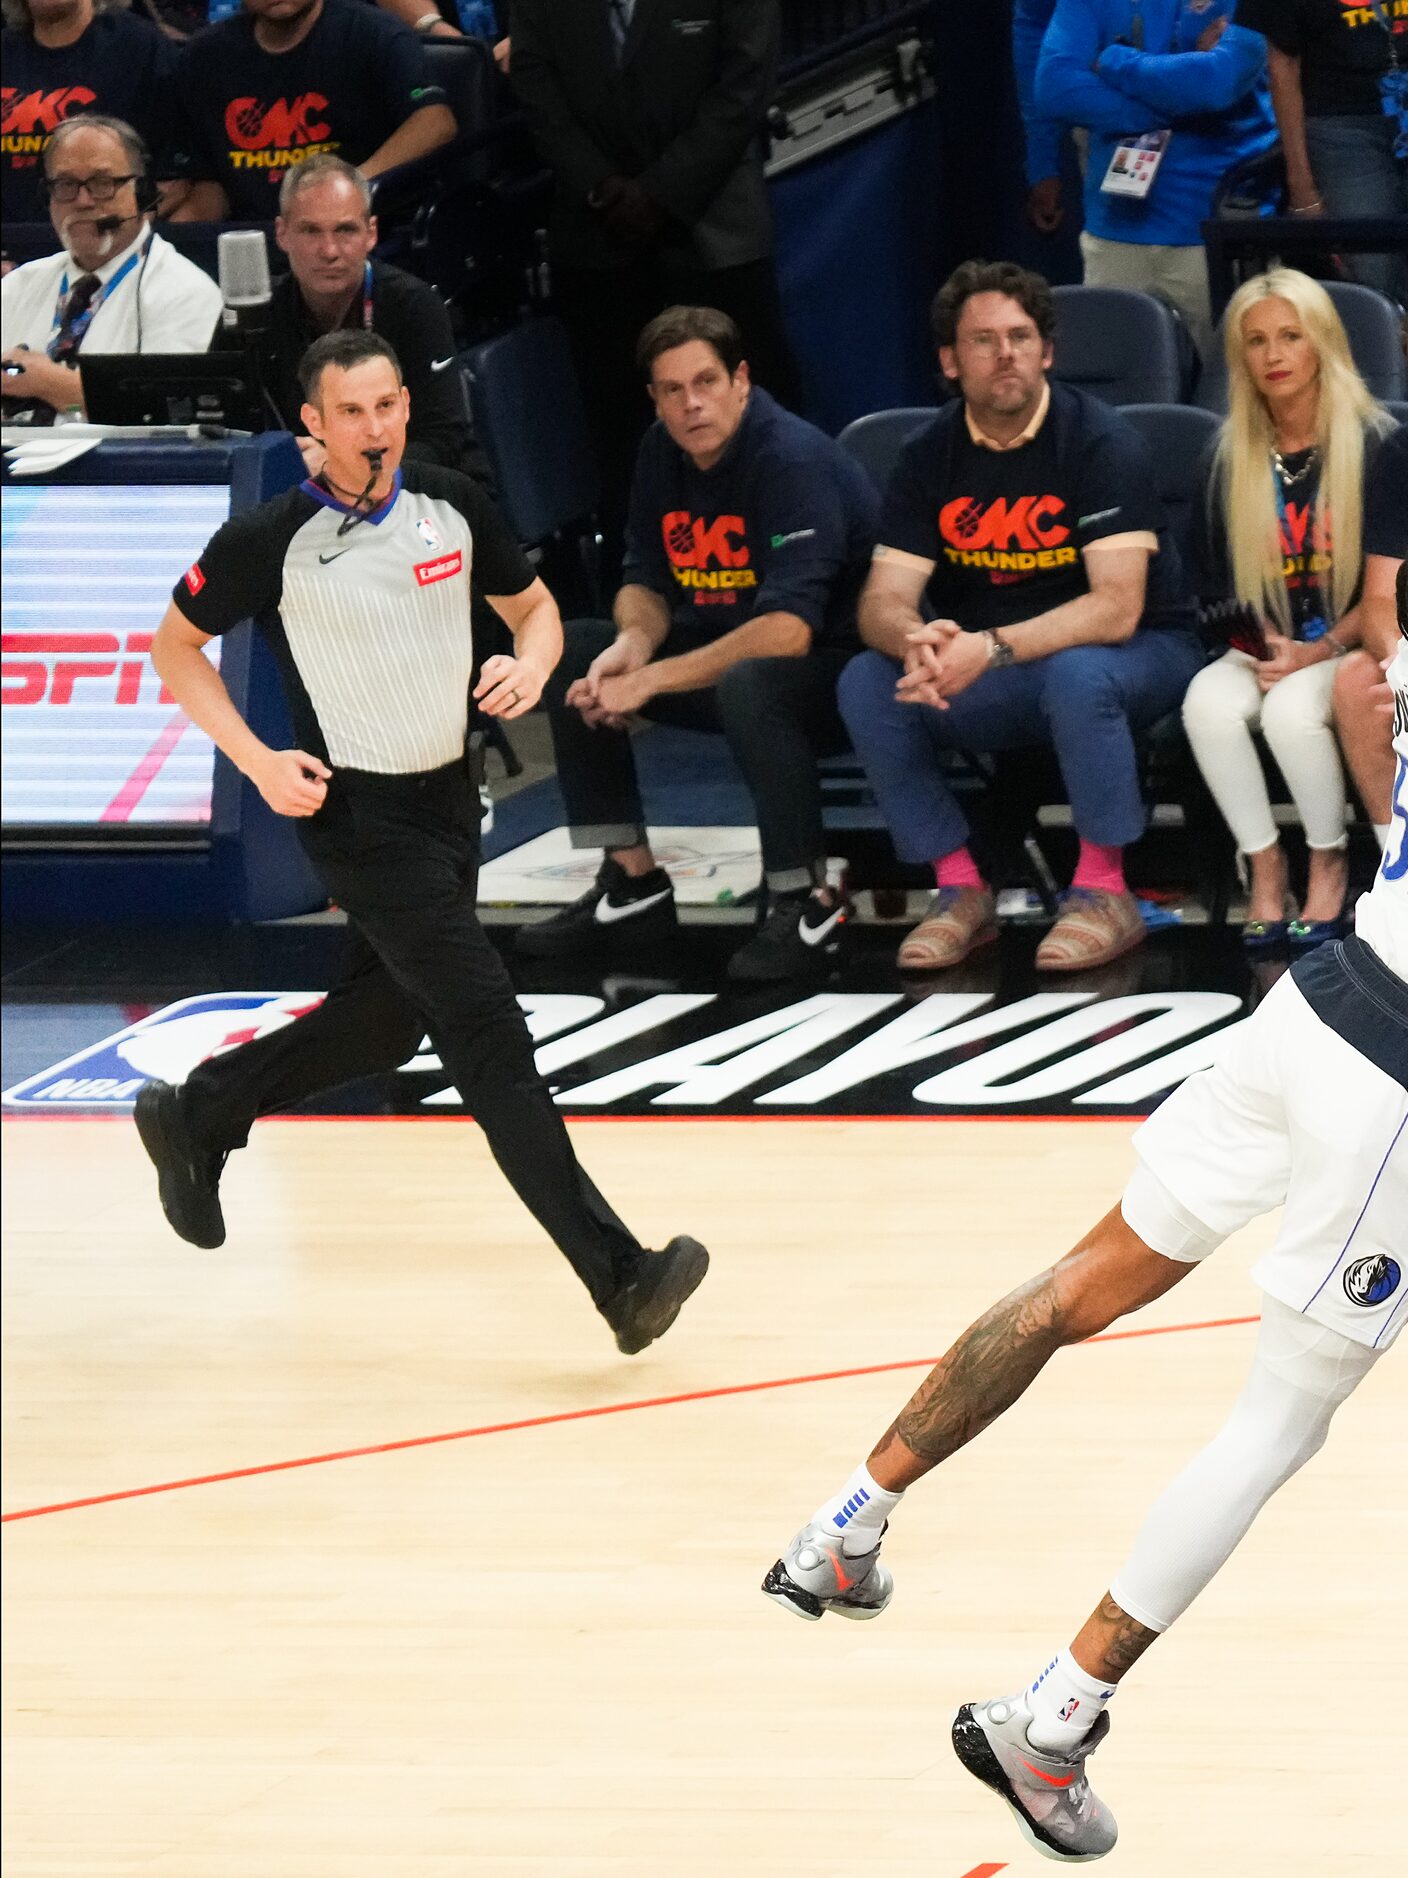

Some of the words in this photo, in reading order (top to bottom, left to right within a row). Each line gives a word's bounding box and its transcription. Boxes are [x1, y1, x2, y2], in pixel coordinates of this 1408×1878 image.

[225, 91, 331, 149] OKC
[661, 510, 750, 569] OKC
[939, 494, 1071, 551] OKC
[943, 546, 1078, 570] THUNDER
[30, 1078, 147, 1099] NBA
